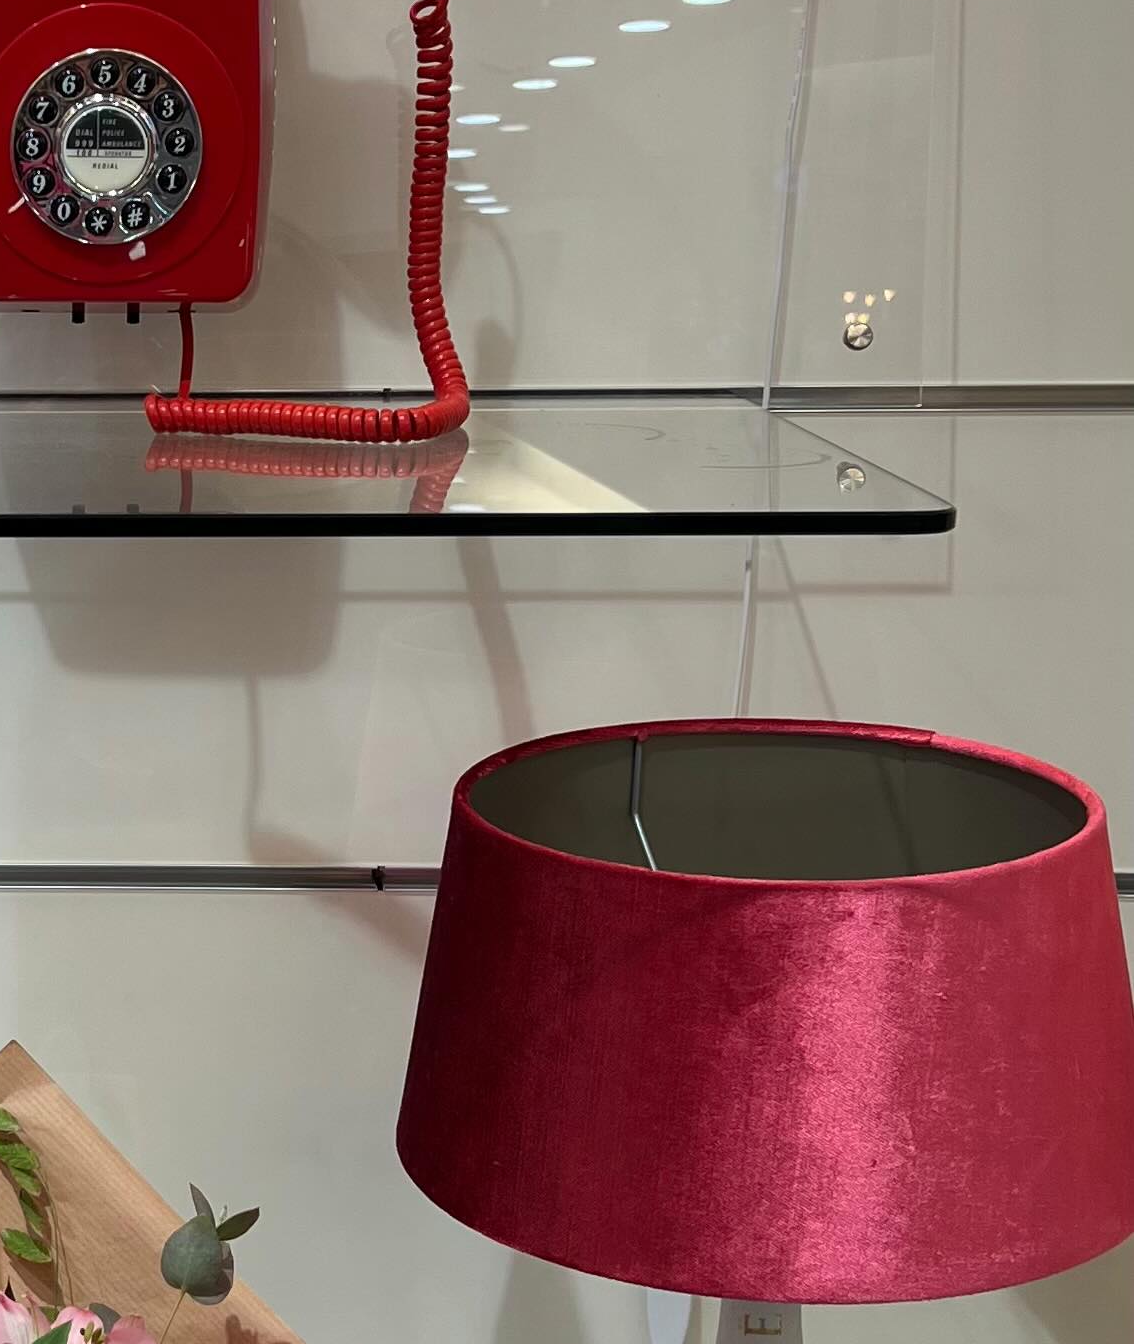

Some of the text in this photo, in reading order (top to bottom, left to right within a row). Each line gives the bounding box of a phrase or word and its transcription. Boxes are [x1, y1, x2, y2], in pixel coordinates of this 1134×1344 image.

[97, 63, 111, 85] 5
[133, 72, 147, 93] 4
[62, 74, 76, 94] 6
[35, 101, 49, 121] 7
[162, 98, 175, 118] 3
[75, 128, 94, 136] DIAL
[25, 138, 39, 157] 8
[74, 140, 94, 148] 999
[173, 138, 187, 154] 2
[32, 176, 46, 194] 9
[167, 171, 178, 190] 1
[57, 199, 70, 221] 0
